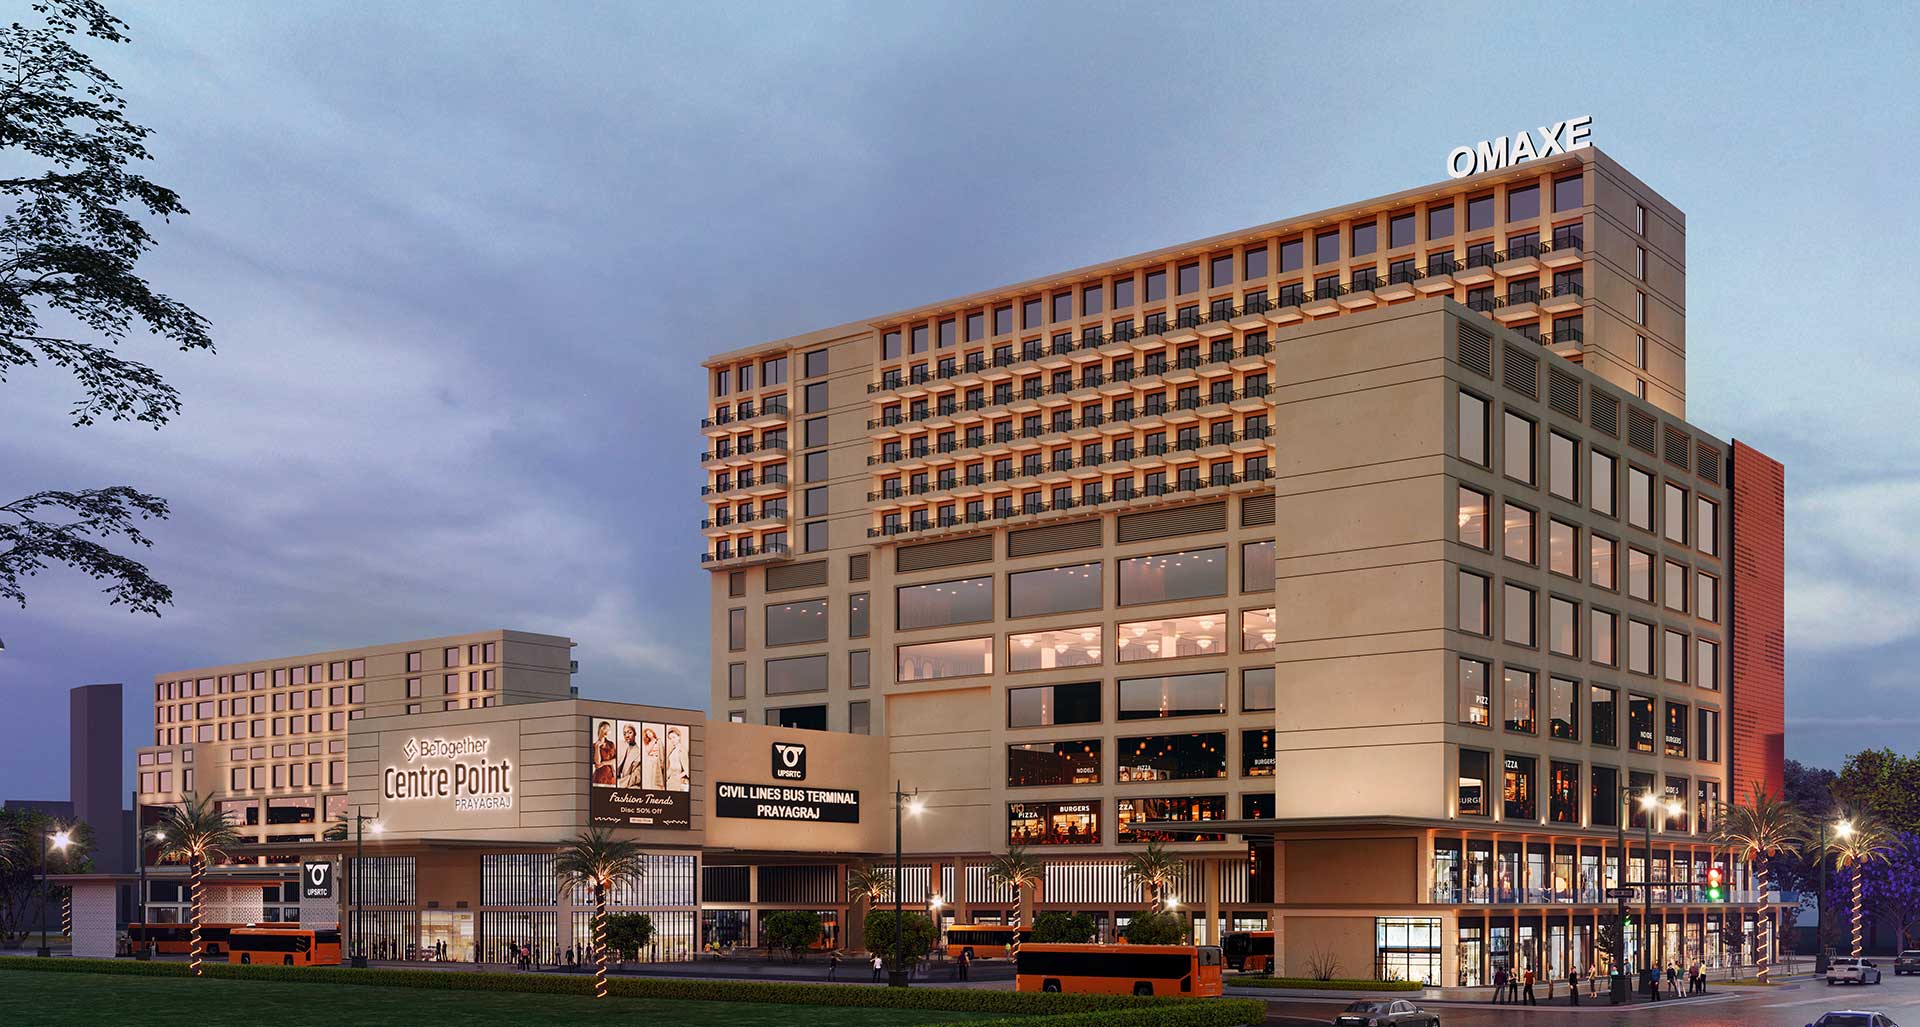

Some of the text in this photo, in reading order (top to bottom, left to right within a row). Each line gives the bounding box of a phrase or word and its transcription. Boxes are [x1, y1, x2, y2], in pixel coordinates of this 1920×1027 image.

[1447, 115, 1592, 179] OMAXE
[420, 737, 488, 759] BeTogether
[384, 759, 510, 799] Centre Point
[777, 769, 802, 778] UPSRTC
[609, 792, 674, 805] Fashion Trends
[719, 785, 857, 805] CIVIL LINES BUS TERMINAL
[455, 797, 511, 809] PRAYAGRAJ
[1060, 805, 1090, 813] BURGERS
[757, 804, 820, 819] PRAYAGRAJ
[307, 888, 328, 896] UPSRTC
